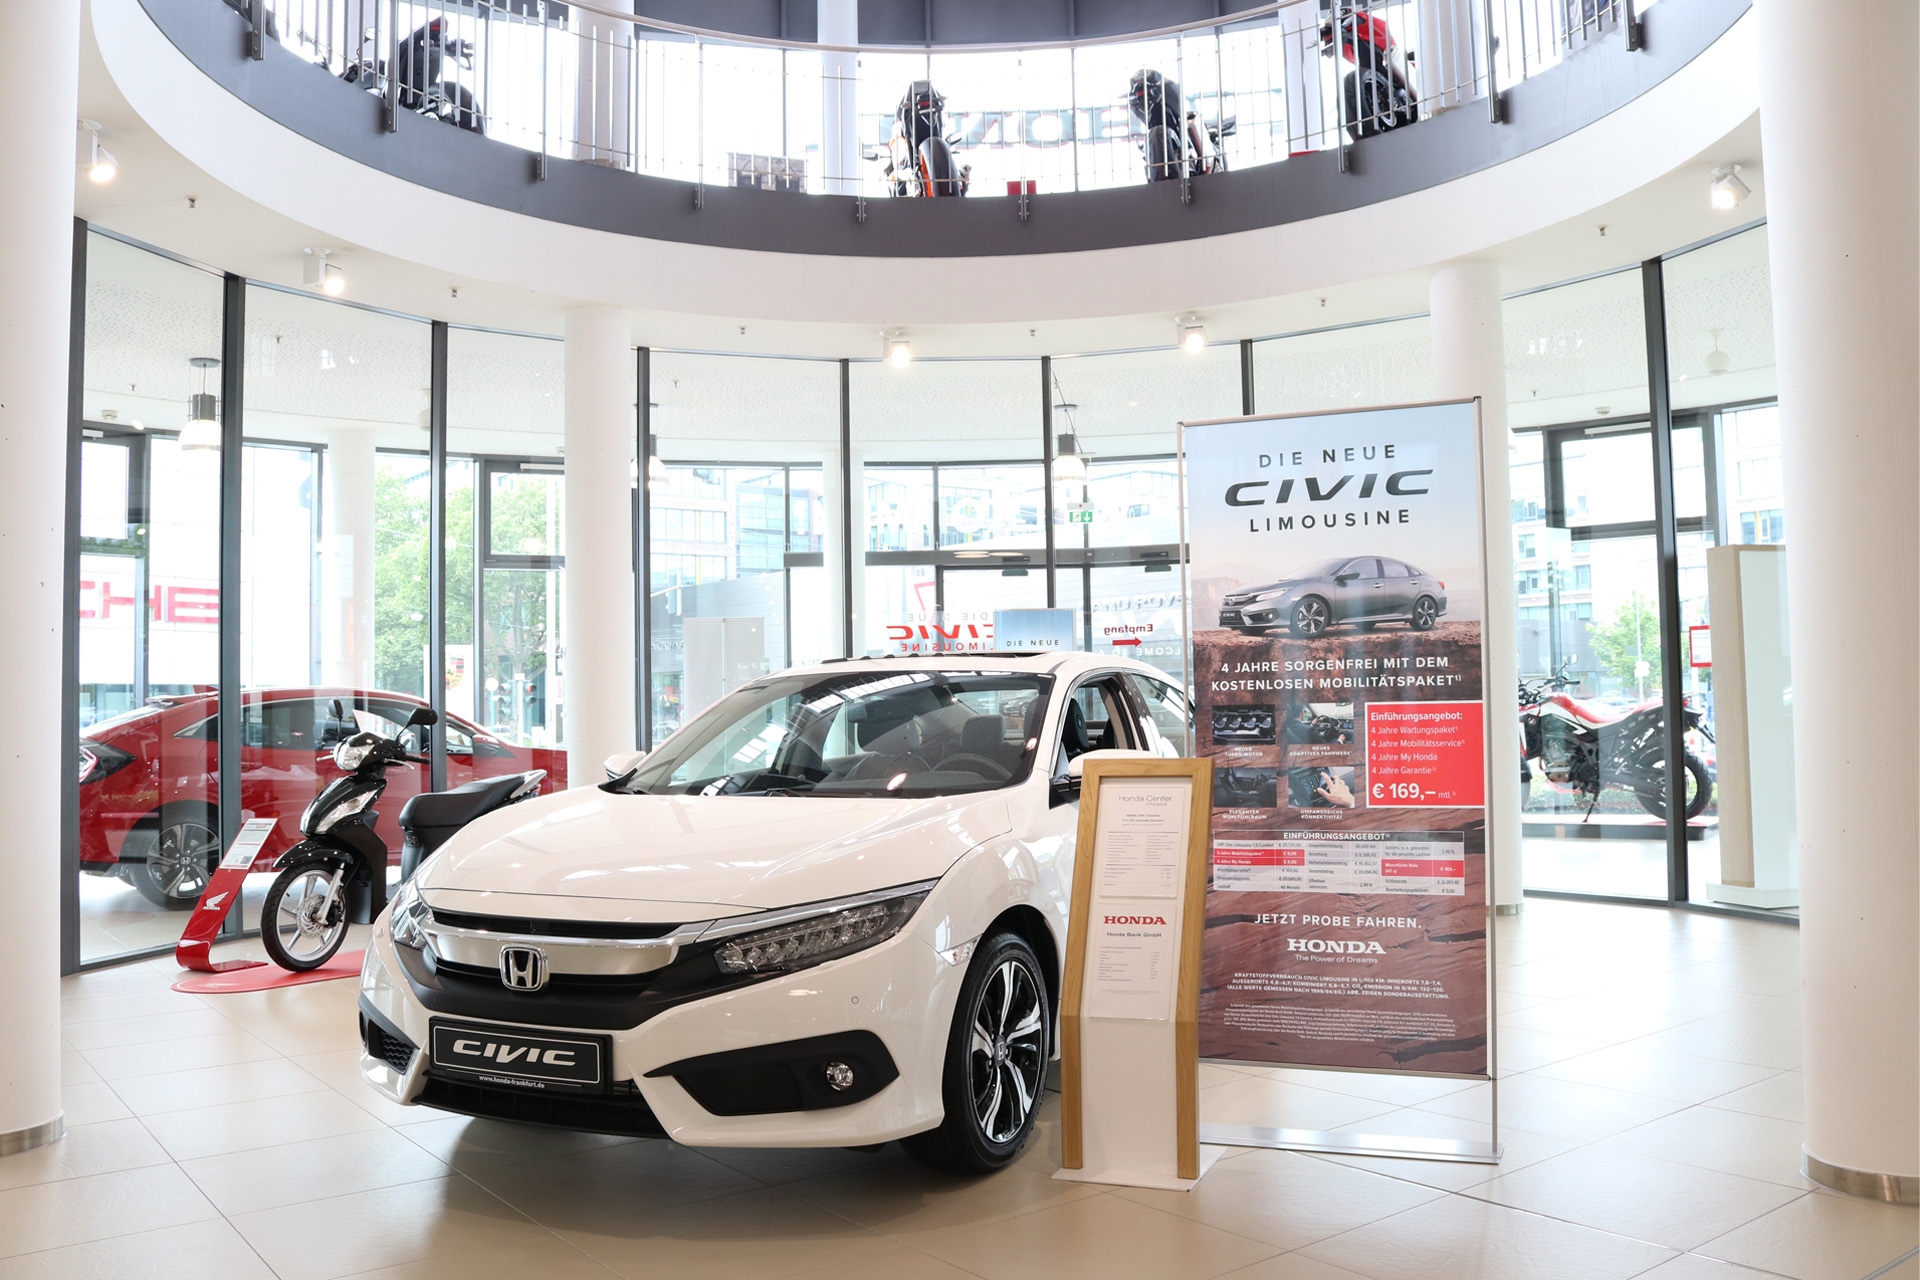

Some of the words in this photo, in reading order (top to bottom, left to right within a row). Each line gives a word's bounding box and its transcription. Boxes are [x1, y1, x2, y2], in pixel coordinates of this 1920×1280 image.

[1259, 451, 1302, 468] DIE
[1322, 444, 1395, 463] NEUE
[1225, 469, 1433, 506] CIVIC
[1250, 509, 1409, 532] LIMOUSINE
[1135, 593, 1192, 610] ROVE
[1222, 663, 1229, 673] 4
[1234, 662, 1279, 673] JAHRE
[1285, 659, 1377, 672] SORGENFREI
[1384, 658, 1409, 669] MIT
[1416, 656, 1448, 668] DEM
[1212, 679, 1313, 691] KOSTENLOSEN
[1371, 712, 1463, 722] Einführungsangebot:
[1371, 726, 1376, 734] 4
[1378, 726, 1398, 734] Jahre
[1371, 740, 1376, 748] 4
[1378, 740, 1398, 748] Jahre
[1371, 753, 1376, 761] 4
[1378, 753, 1398, 761] Jahre
[1400, 753, 1411, 762] My
[1413, 753, 1438, 761] Honda
[1372, 783, 1384, 799] €
[1104, 916, 1167, 925] HONDA
[1254, 914, 1296, 924] JETZT
[1302, 915, 1350, 927] PROBE
[1356, 916, 1422, 928] FAHREN.
[1287, 938, 1386, 954] HONDA
[1310, 955, 1335, 963] Power
[1347, 956, 1378, 964] Dreams
[452, 1039, 576, 1066] CIVIC
[479, 1074, 545, 1088] www.honda-frankfurt.de
